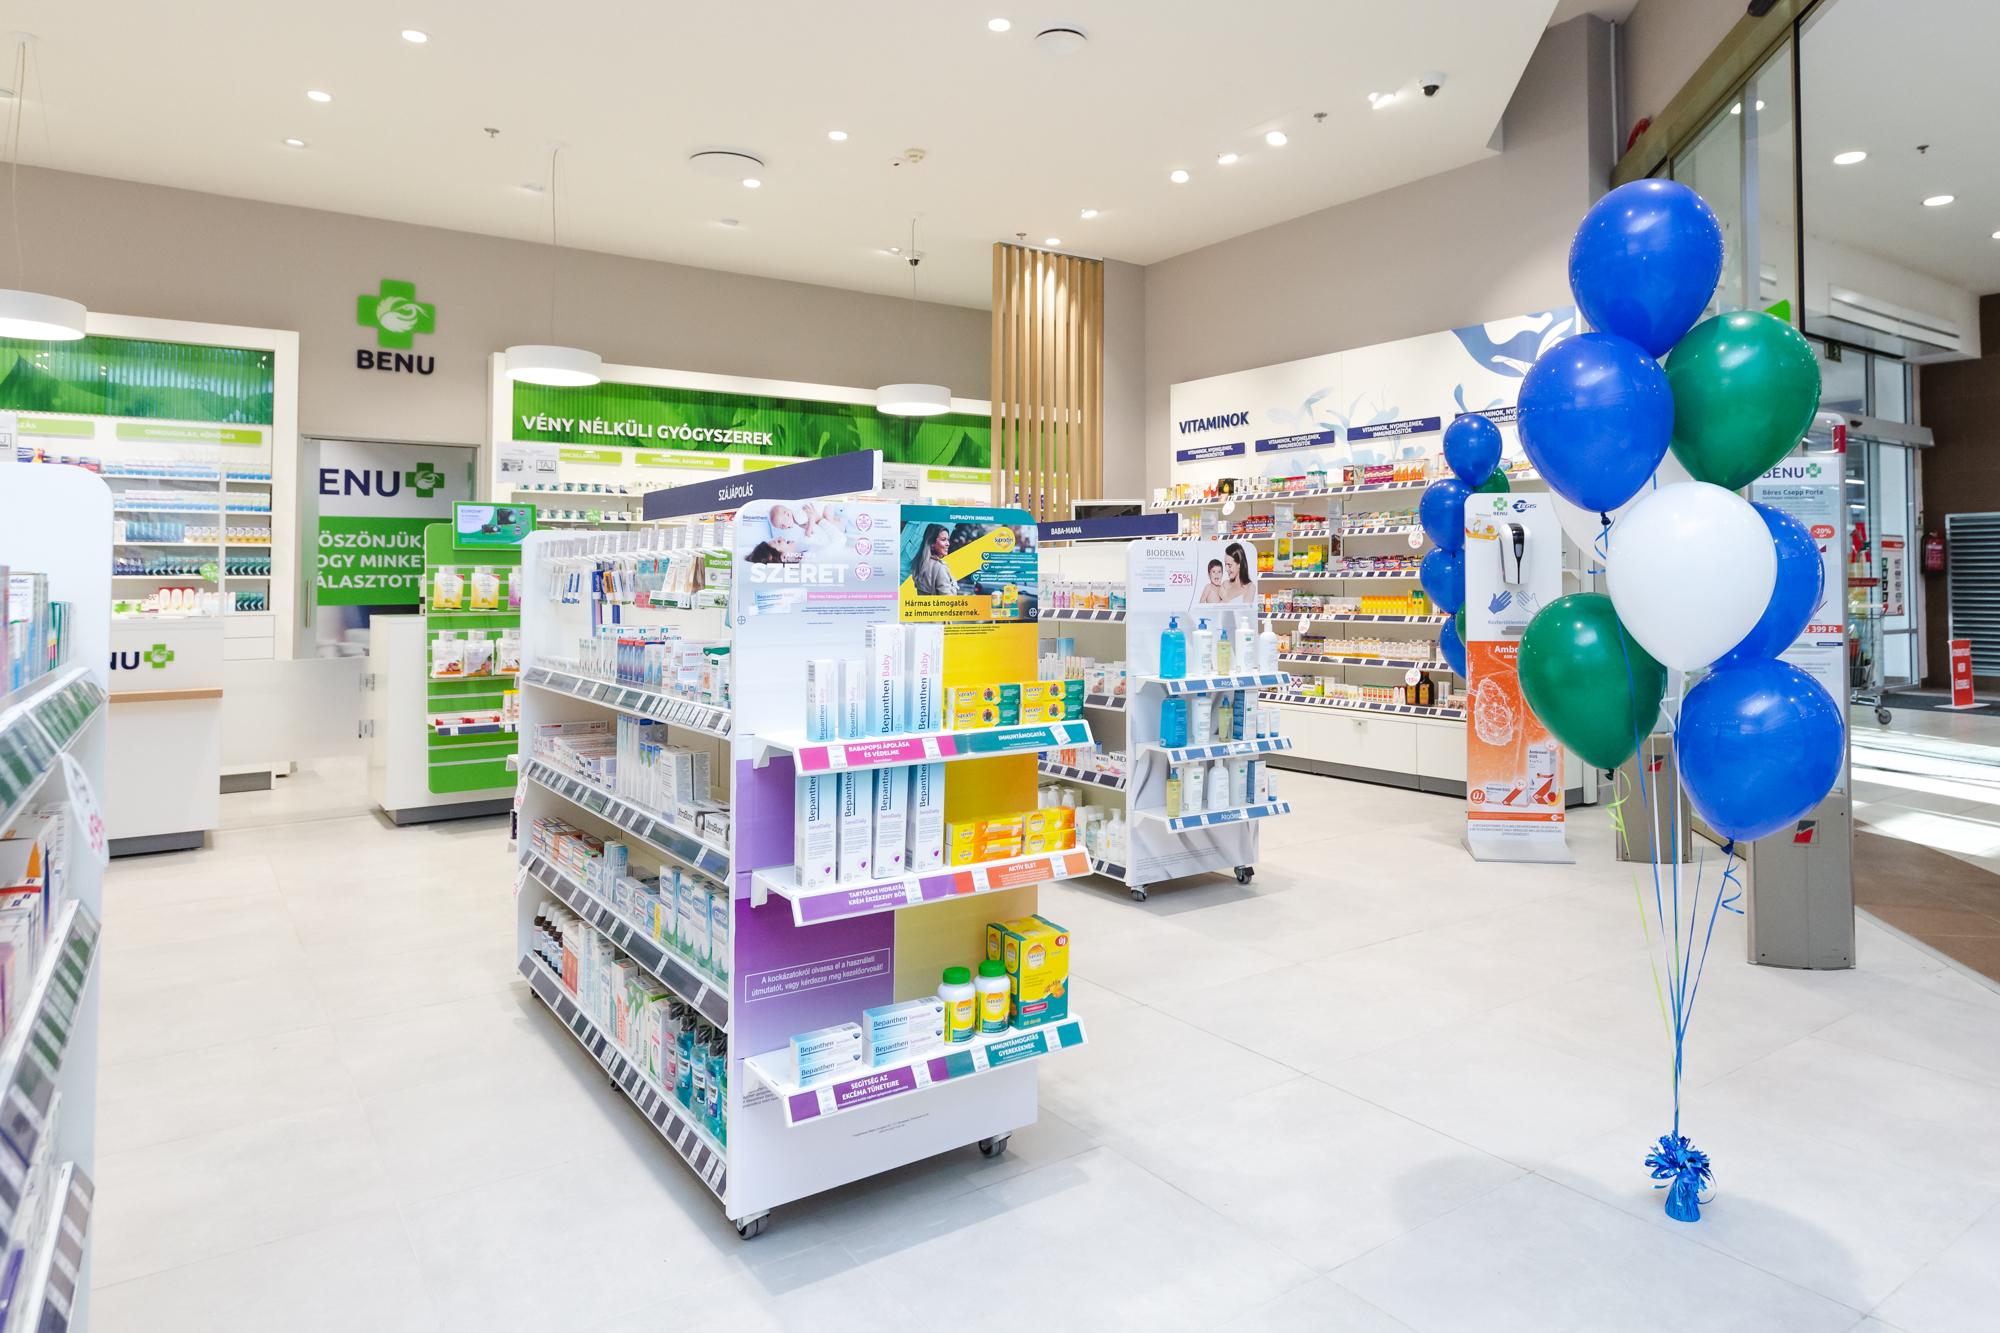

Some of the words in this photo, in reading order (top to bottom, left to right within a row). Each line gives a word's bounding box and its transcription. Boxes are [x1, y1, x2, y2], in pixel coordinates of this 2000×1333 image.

[356, 349, 436, 375] BENU
[521, 412, 575, 434] VÉNY
[578, 416, 653, 439] NÉLKÜLI
[657, 422, 774, 447] GYÓGYSZEREK
[1179, 411, 1249, 434] VITAMINOK
[319, 468, 400, 497] ENU
[718, 481, 754, 502] SZÁJÁPOLÁS
[1050, 525, 1082, 536] BABA-MAMA
[318, 530, 425, 550] ÖSZÖNJÜK,
[317, 553, 358, 568] OGY
[360, 554, 425, 569] MINKE
[1146, 549, 1185, 557] BIODERMA
[317, 571, 421, 589] ÁLASZTOT
[750, 562, 850, 585] SZERET
[1169, 573, 1191, 585] -25%
[932, 600, 968, 609] támogatás
[914, 609, 980, 617] immunrendszernek.
[1494, 645, 1519, 653] Ambr
[882, 654, 891, 677] Baby
[920, 652, 930, 675] Baby
[882, 680, 891, 733] Bepanthen
[918, 677, 928, 730] Bepanthen
[998, 730, 1046, 742] IMMUNTÁMOGATÁS
[848, 744, 882, 753] BABAPOPSI
[882, 740, 910, 749] ÁPOLÁSA
[864, 750, 873, 758] ÉS
[873, 747, 900, 757] VÉDELME
[1472, 791, 1483, 800] ÚJ
[1008, 864, 1024, 873] AKTÍV
[1024, 862, 1036, 870] ÉLET
[848, 888, 878, 898] TARTÓSAN
[879, 882, 905, 894] HIDRATÁL
[848, 896, 865, 906] KRÉM
[761, 976, 767, 984] A
[767, 968, 810, 983] kockázatokról
[811, 964, 834, 975] olvassa
[834, 962, 841, 970] el
[785, 980, 800, 990] vagy
[828, 972, 842, 981] meg
[873, 1015, 908, 1028] Bepanthen
[800, 1040, 834, 1054] Bepanthen
[875, 1040, 909, 1053] Bepanthen
[990, 1033, 1039, 1051] IMMUNTÁMOGATÁS
[801, 1062, 835, 1077] Bepanthen
[842, 1087, 867, 1101] EKCÉMA
[867, 1079, 899, 1095] TÜNETEIRE
[850, 1076, 878, 1090] SEGÍTSÉG
[878, 1074, 888, 1083] AZ
